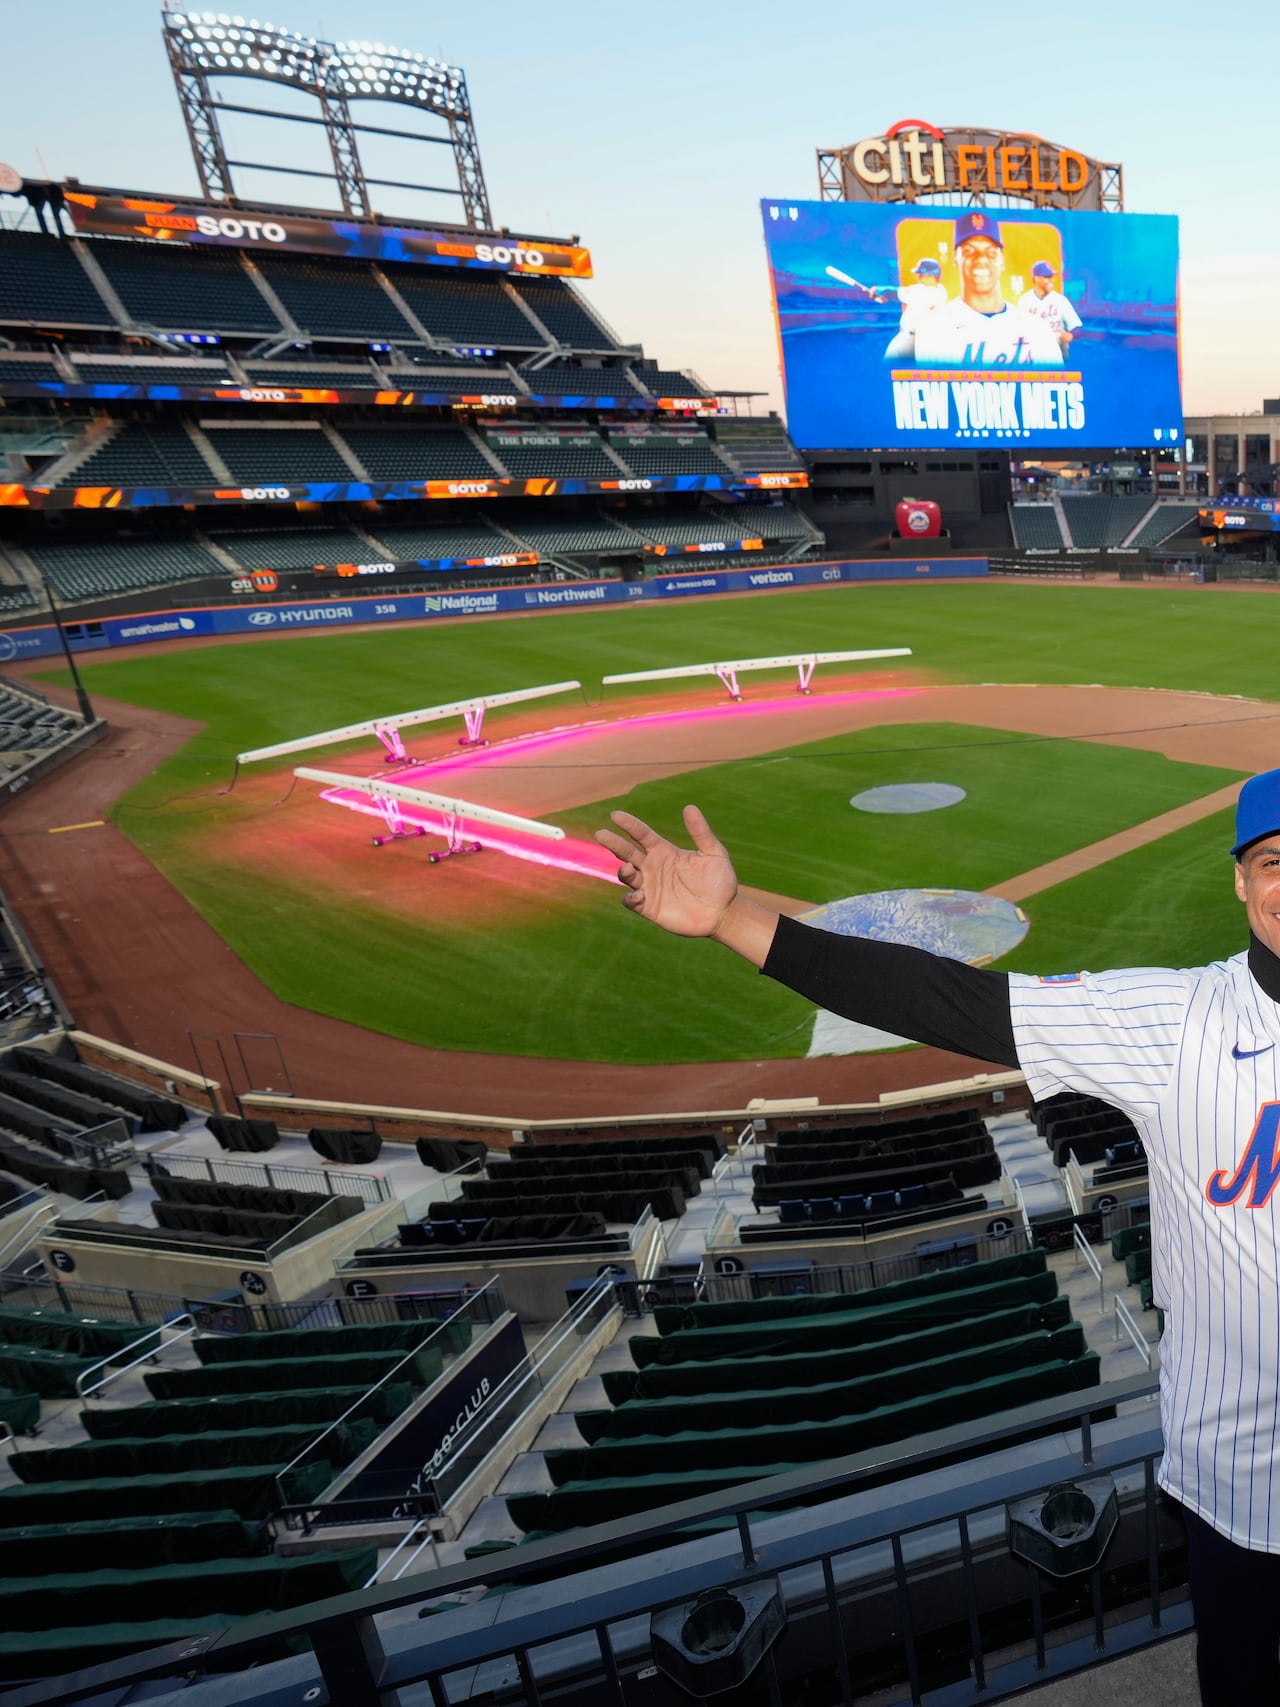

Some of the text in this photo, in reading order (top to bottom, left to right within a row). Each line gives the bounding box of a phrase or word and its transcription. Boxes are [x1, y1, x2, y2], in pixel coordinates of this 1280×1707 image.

[853, 130, 1089, 191] citi FIELD
[196, 215, 287, 243] SOTO
[475, 244, 544, 267] SOTO
[240, 389, 285, 400] SOTO
[481, 395, 516, 406] SOTO
[673, 400, 702, 409] SOTO
[892, 381, 1086, 430] NEW YORK METS
[498, 436, 521, 446] THE
[522, 436, 560, 446] PORCH
[618, 479, 652, 490] SOTO
[761, 476, 789, 486] SOTO
[240, 488, 290, 500] SOTO
[448, 483, 488, 494] SOTO
[1224, 516, 1245, 525] SOTO
[699, 542, 726, 552] SOTO
[484, 555, 517, 566] SOTO
[357, 563, 396, 574] SOTO
[822, 566, 841, 580] citi
[749, 570, 794, 585] verizon
[442, 594, 498, 609] National
[538, 587, 605, 603] Northwell
[280, 606, 353, 623] HYUNDAI
[375, 604, 397, 615] 358
[120, 621, 180, 638] smartwater
[993, 1221, 1008, 1236] D
[721, 1260, 736, 1275] D
[456, 1377, 490, 1430] CLUB
